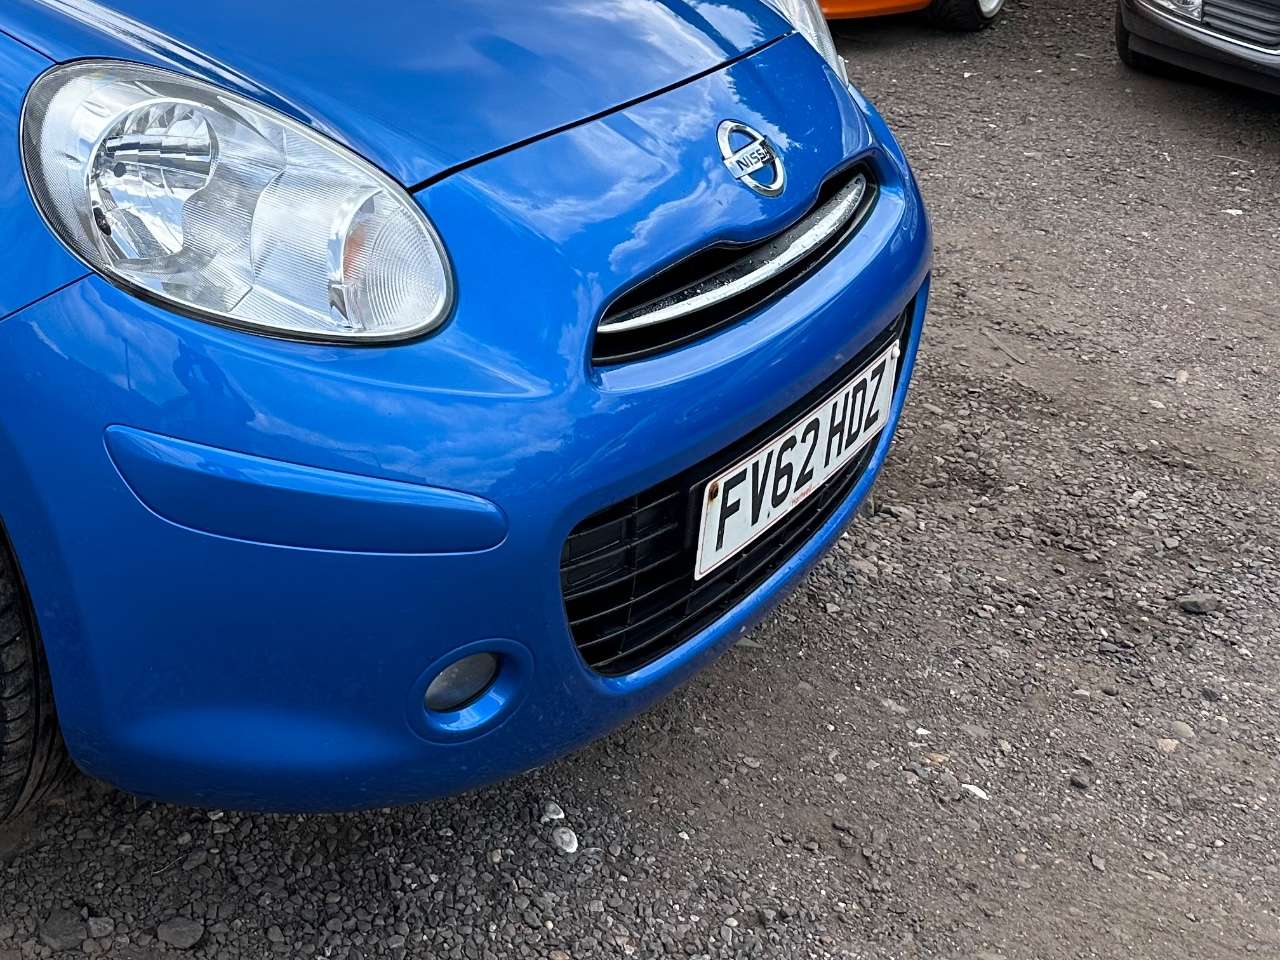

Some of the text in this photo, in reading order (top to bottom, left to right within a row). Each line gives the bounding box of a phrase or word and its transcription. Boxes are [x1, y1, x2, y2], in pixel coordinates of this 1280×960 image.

[735, 146, 770, 171] NISS
[716, 358, 887, 551] FV62 HDZ
